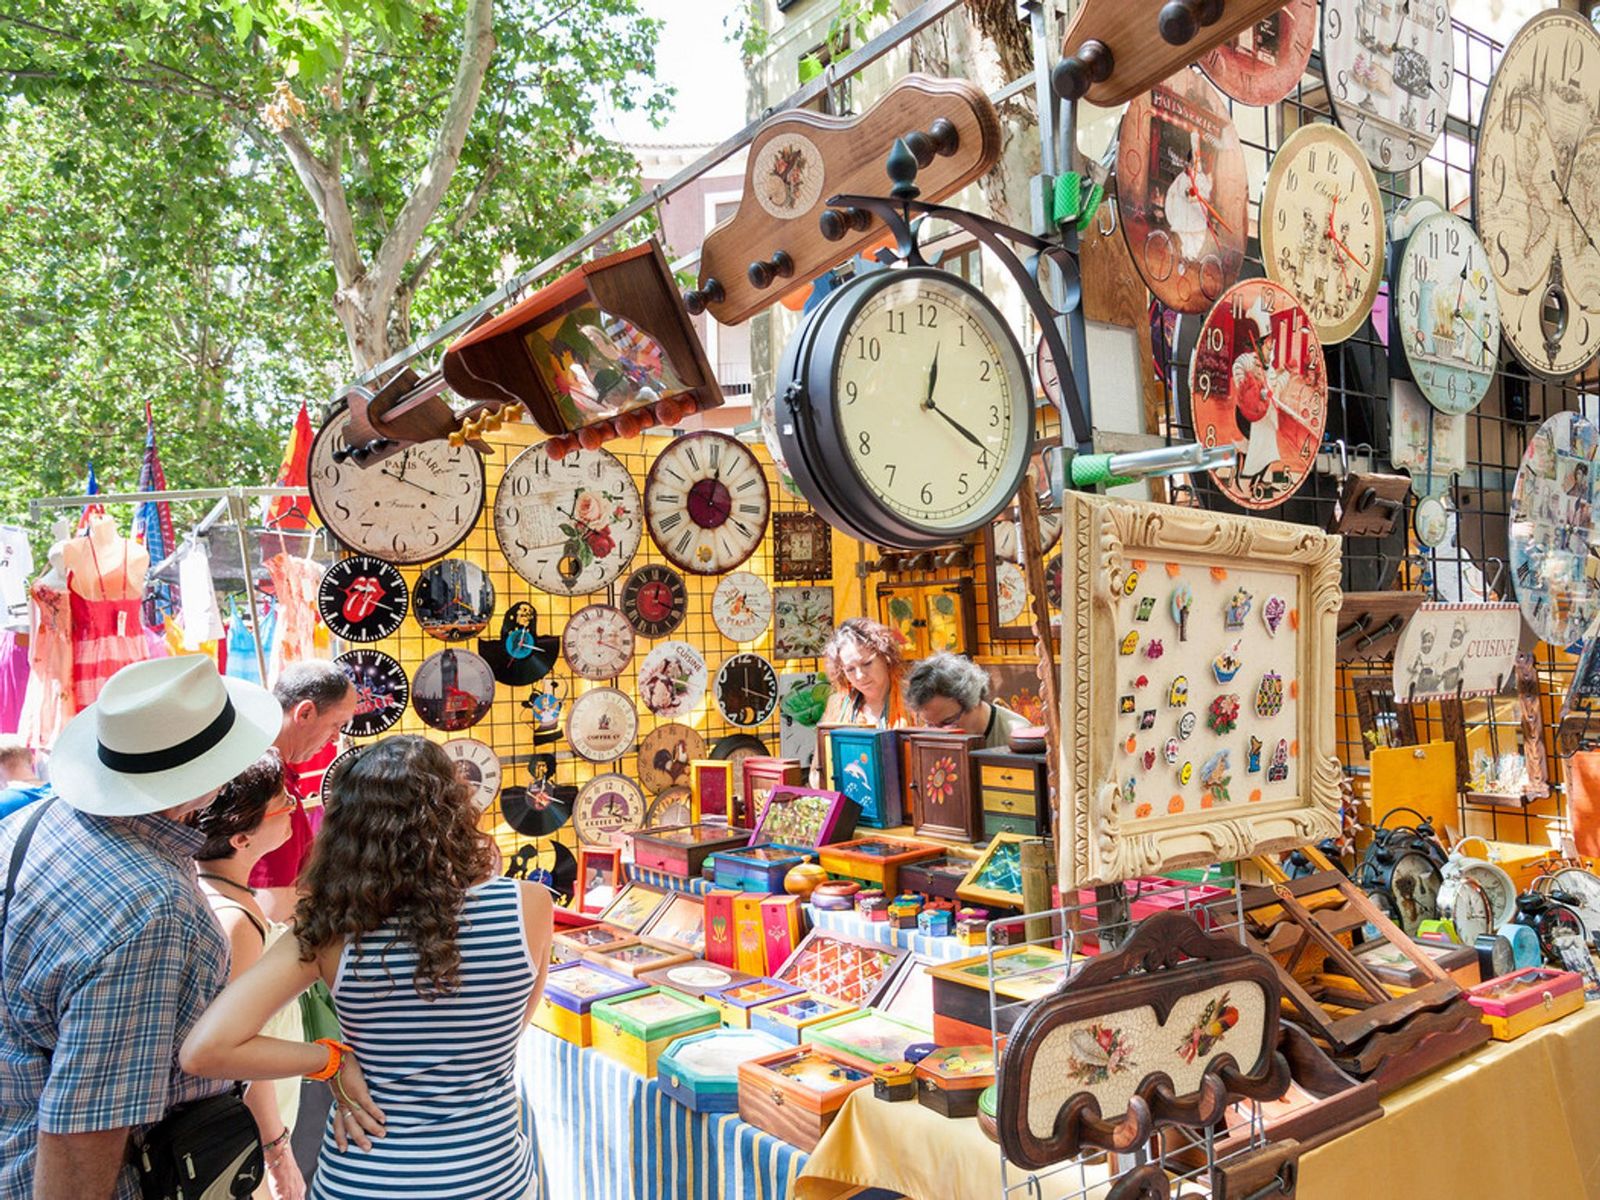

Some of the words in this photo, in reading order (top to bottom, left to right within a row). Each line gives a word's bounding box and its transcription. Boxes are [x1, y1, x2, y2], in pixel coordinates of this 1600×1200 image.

[1328, 8, 1342, 40] 9
[1435, 5, 1446, 34] 2
[1562, 36, 1584, 89] 12
[1336, 70, 1348, 100] 8
[1439, 61, 1449, 89] 3
[1356, 114, 1366, 142] 7
[1425, 108, 1436, 133] 4
[1380, 137, 1392, 165] 6
[1405, 134, 1417, 160] 5
[1125, 149, 1142, 183] 9
[1308, 148, 1316, 173] 11
[1327, 151, 1338, 175] 12
[1286, 168, 1298, 192] 10
[1350, 171, 1356, 192] 1
[1492, 154, 1506, 203] 9
[1278, 208, 1287, 231] 9
[1360, 202, 1370, 225] 2
[1429, 232, 1438, 260] 11
[1445, 228, 1460, 257] 12
[1414, 253, 1428, 282] 10
[1261, 286, 1275, 313] 12
[1478, 276, 1488, 301] 2
[917, 304, 938, 328] 12
[1230, 292, 1244, 319] 11
[1410, 290, 1420, 318] 9
[887, 310, 906, 334] 11
[1291, 306, 1298, 333] 1
[1483, 312, 1492, 339] 3
[958, 325, 966, 346] 1
[1207, 327, 1224, 352] 10
[1415, 330, 1426, 357] 8
[858, 336, 881, 361] 10
[1308, 345, 1319, 369] 2
[979, 360, 990, 382] 2
[846, 381, 858, 405] 9
[1199, 373, 1212, 401] 9
[1447, 374, 1457, 401] 6
[988, 405, 999, 427] 3
[1312, 392, 1321, 416] 3
[859, 431, 871, 455] 8
[1205, 424, 1217, 448] 8
[1300, 434, 1311, 460] 4
[977, 449, 988, 470] 4
[325, 464, 340, 487] 9
[457, 473, 471, 495] 3
[512, 475, 531, 496] 10
[884, 465, 897, 488] 7
[957, 473, 969, 494] 5
[1282, 466, 1294, 490] 5
[612, 480, 625, 500] 2
[920, 482, 933, 504] 6
[1252, 475, 1265, 501] 6
[334, 500, 350, 521] 8
[446, 505, 463, 525] 4
[506, 506, 520, 527] 9
[361, 523, 374, 544] 7
[392, 533, 407, 554] 6
[423, 525, 439, 546] 5
[537, 559, 548, 580] 7
[1466, 637, 1516, 659] CUISINE
